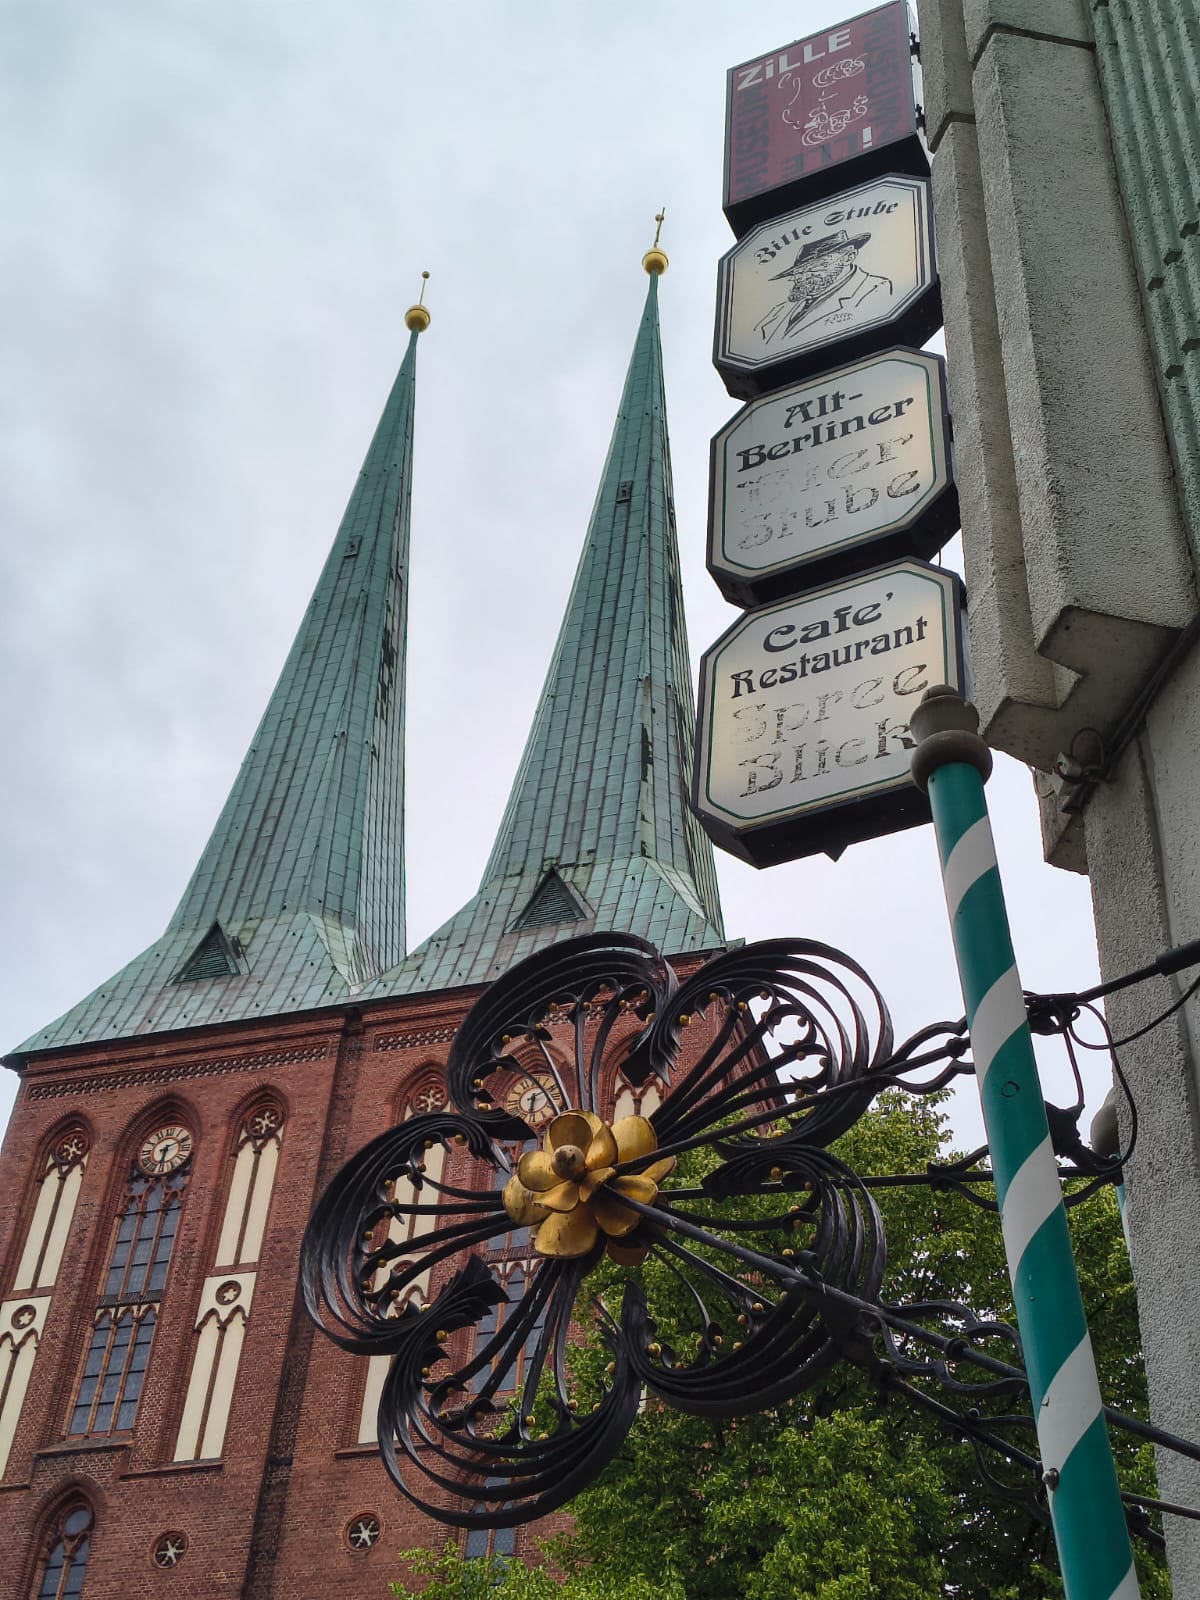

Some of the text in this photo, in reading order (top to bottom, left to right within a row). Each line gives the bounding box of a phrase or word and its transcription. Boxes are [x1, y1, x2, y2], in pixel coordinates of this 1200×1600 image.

[823, 199, 899, 226] Stube
[736, 397, 914, 473] Berliner
[783, 390, 863, 429] Alt-
[730, 615, 928, 699] Restaurant
[731, 663, 929, 745] Spree
